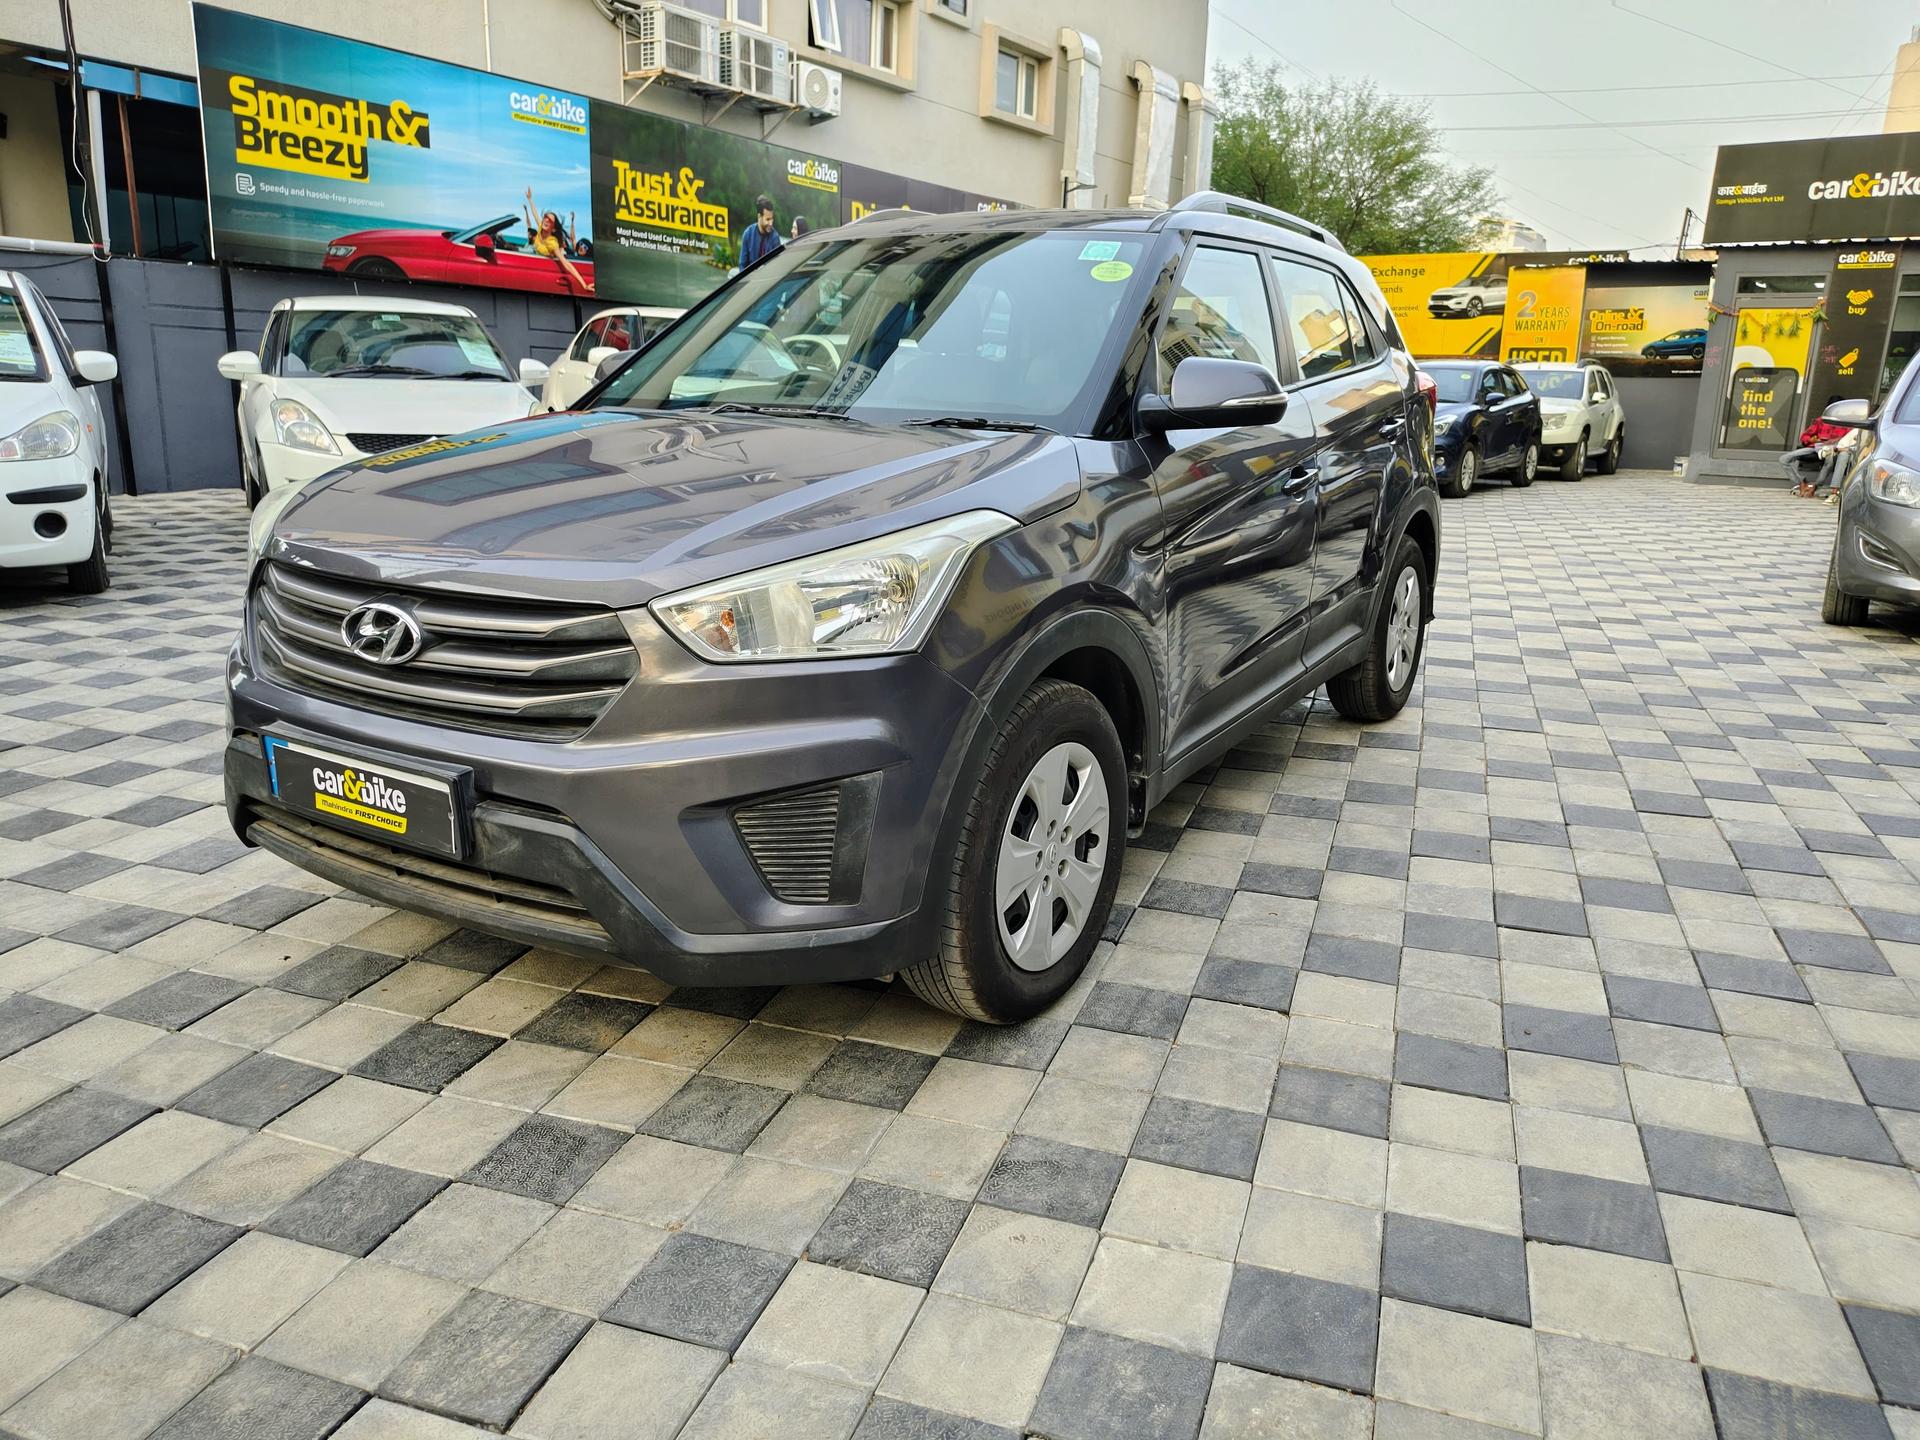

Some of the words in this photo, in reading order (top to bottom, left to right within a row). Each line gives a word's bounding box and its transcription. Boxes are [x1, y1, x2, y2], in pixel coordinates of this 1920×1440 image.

[229, 75, 381, 140] Smooth
[386, 99, 430, 148] &
[510, 92, 586, 124] car&bike
[236, 115, 369, 180] Breezy
[788, 159, 838, 183] car&bike
[613, 160, 673, 198] Trust
[677, 166, 704, 203] &
[1807, 171, 1920, 200] car&bike
[260, 182, 289, 196] Speedy
[290, 188, 305, 196] and
[306, 189, 347, 202] hassle-free
[616, 189, 726, 232] Assurance
[616, 226, 632, 236] Most
[632, 229, 647, 239] loved
[648, 232, 662, 241] Used
[663, 234, 672, 242] Car
[673, 236, 689, 245] brand
[695, 240, 708, 249] India
[629, 238, 656, 250] Franchise
[1838, 251, 1895, 263] car&bike
[1371, 266, 1426, 278] Exchange
[1517, 289, 1538, 319] 2
[1540, 306, 1570, 319] YEARS
[1589, 309, 1625, 321] Online
[1627, 305, 1644, 320] &
[1848, 306, 1867, 315] buy
[1515, 319, 1568, 331] WARRANTY
[1596, 321, 1644, 331] On-road
[1838, 367, 1854, 375] sell
[1743, 390, 1774, 402] find
[1740, 403, 1766, 415] the
[1738, 417, 1772, 429] one!
[312, 767, 407, 814] car&bike
[355, 809, 376, 821] FIRST
[376, 816, 403, 829] CHOICE
